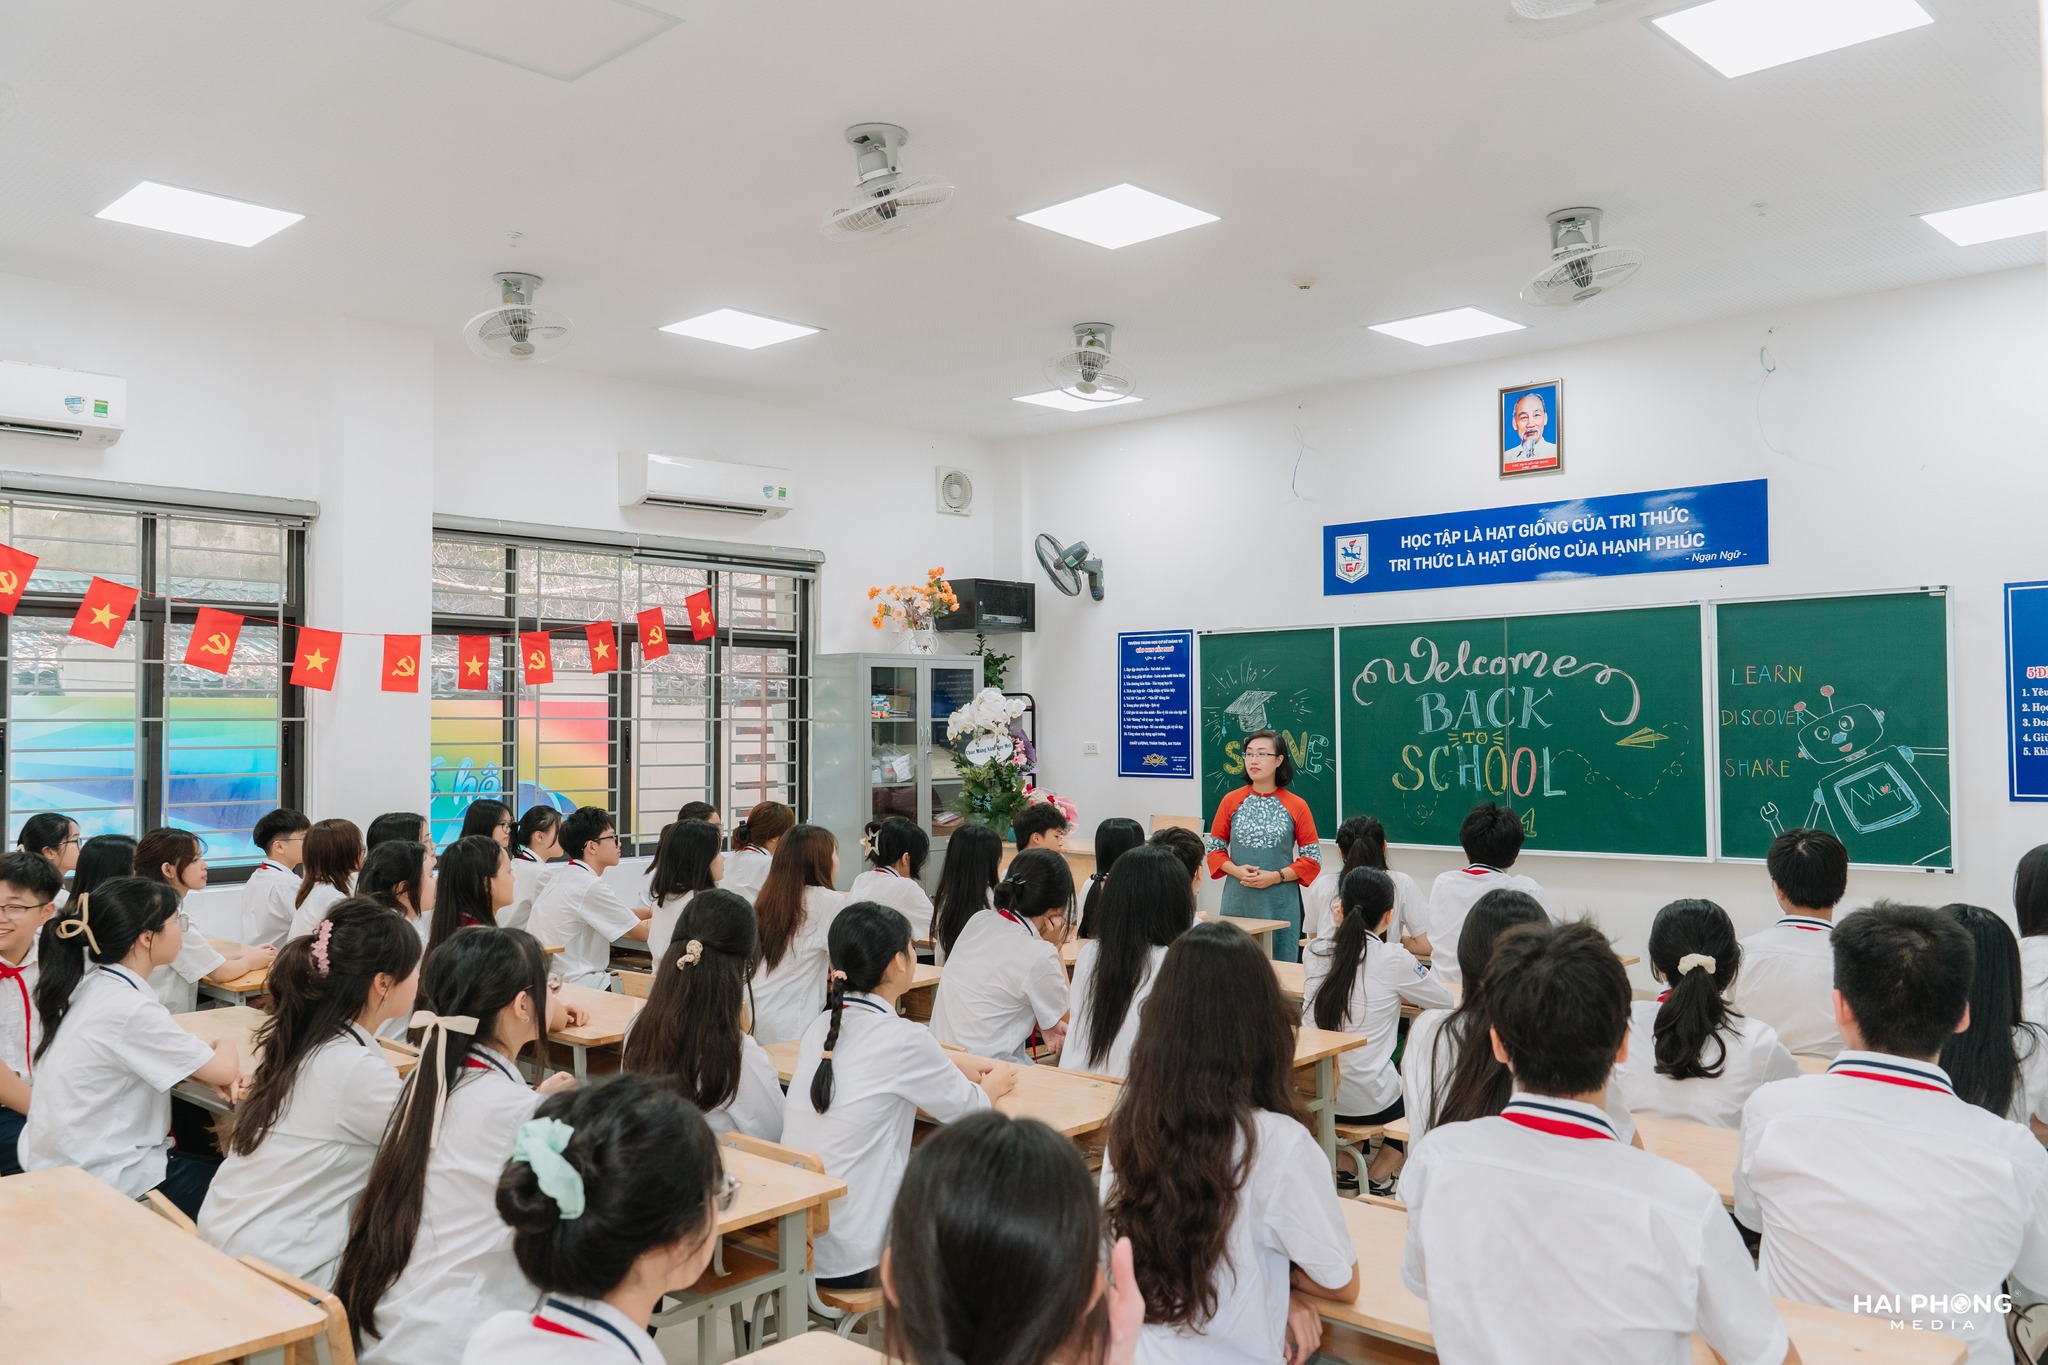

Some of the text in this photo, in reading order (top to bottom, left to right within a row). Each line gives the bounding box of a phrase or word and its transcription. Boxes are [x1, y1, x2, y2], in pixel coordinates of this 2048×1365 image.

[1401, 507, 1689, 550] HỌC TẬP LÀ HẠT GIỐNG CỦA TRI THỨC
[1389, 530, 1705, 572] TRI THỨC LÀ HẠT GIỐNG CỦA HẠNH PHÚC
[1691, 553, 1717, 564] Ngạn
[1719, 550, 1742, 562] Ngữ
[1352, 637, 1612, 706] Welcome
[1732, 665, 1802, 685] LEARN
[2026, 666, 2048, 679] 5 Đ
[2022, 688, 2030, 697] 1.
[1416, 686, 1553, 735] BACK
[2022, 703, 2030, 712] 2.
[1721, 709, 1806, 726] DISCOVER
[2022, 718, 2031, 727] 3.
[1463, 732, 1487, 744] TO
[2023, 733, 2031, 742] 4.
[2023, 746, 2031, 756] 5.
[1392, 745, 1566, 797] SCHOOL
[1725, 758, 1790, 778] SHARE
